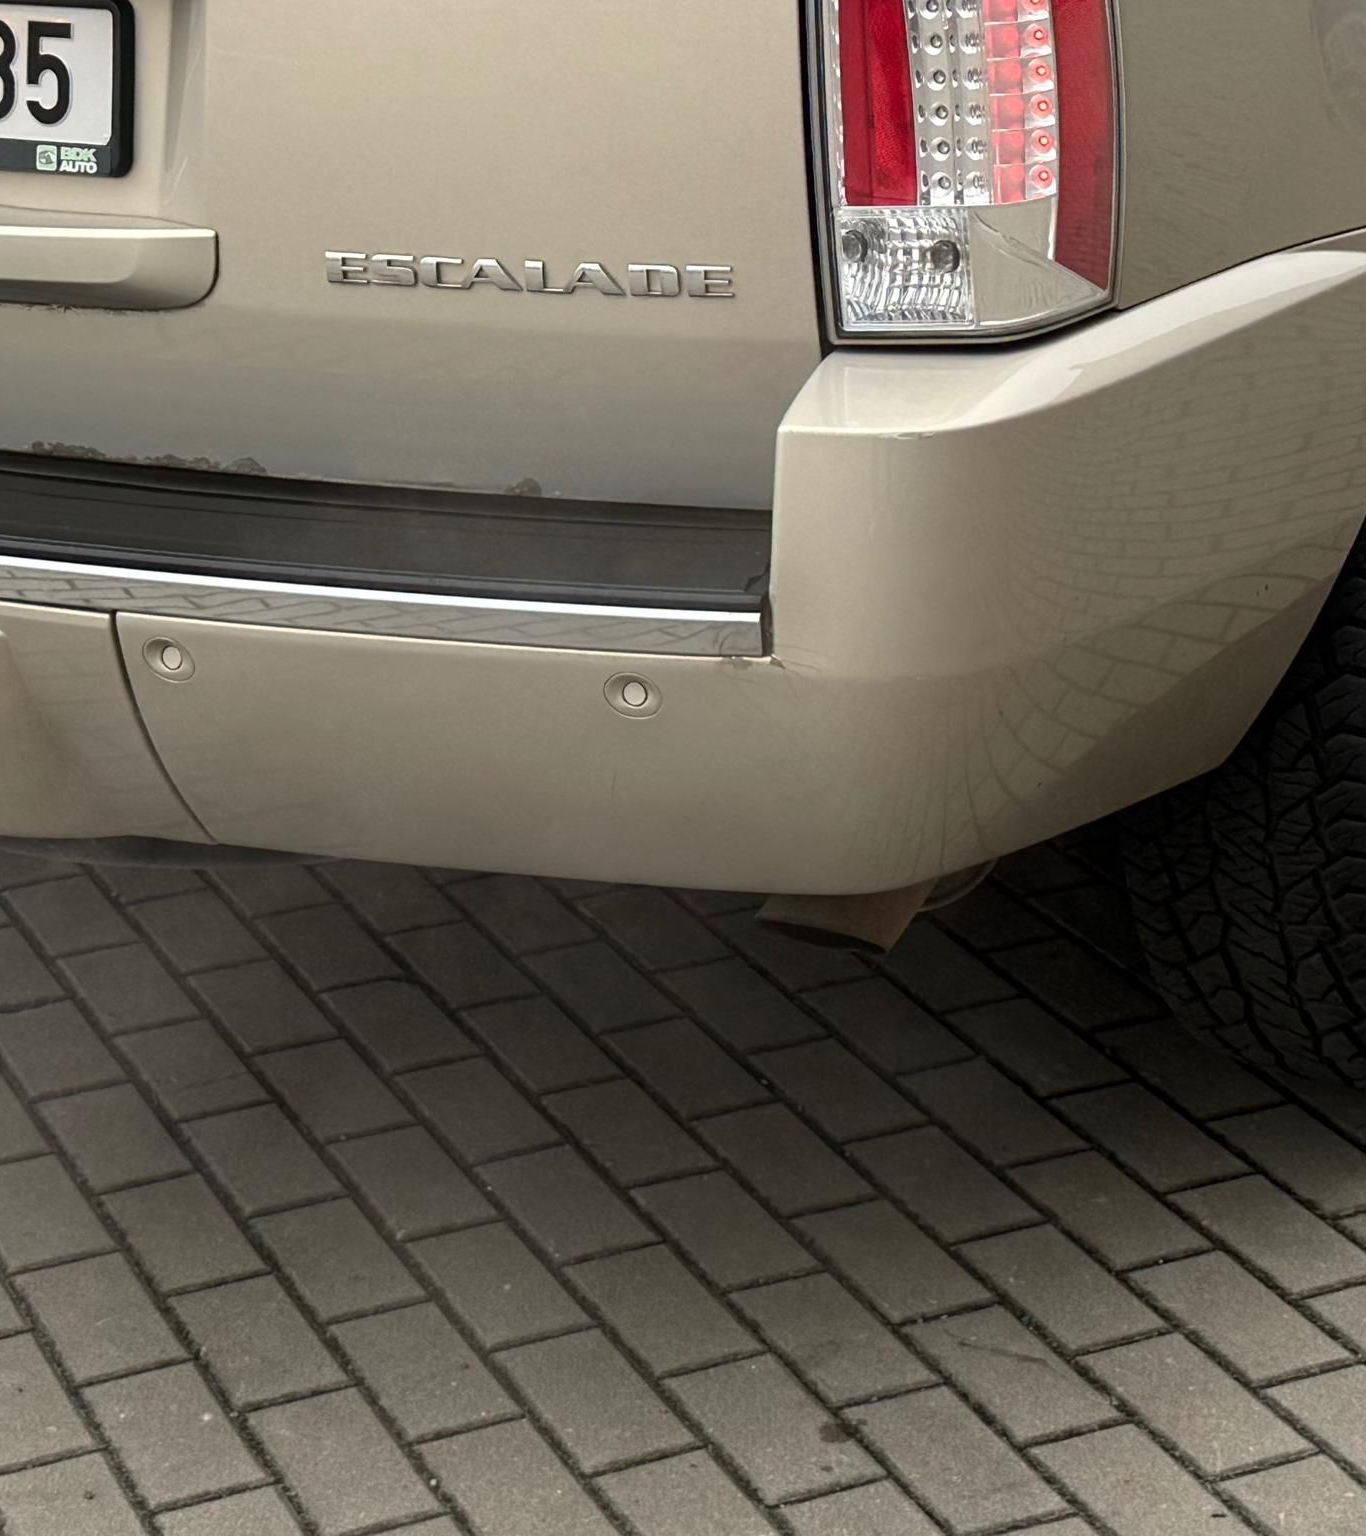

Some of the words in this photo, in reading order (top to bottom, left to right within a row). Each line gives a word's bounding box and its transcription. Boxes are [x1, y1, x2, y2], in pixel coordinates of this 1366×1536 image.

[60, 146, 97, 162] BDK
[59, 160, 98, 174] AUTO
[324, 250, 735, 298] ESCALADE
